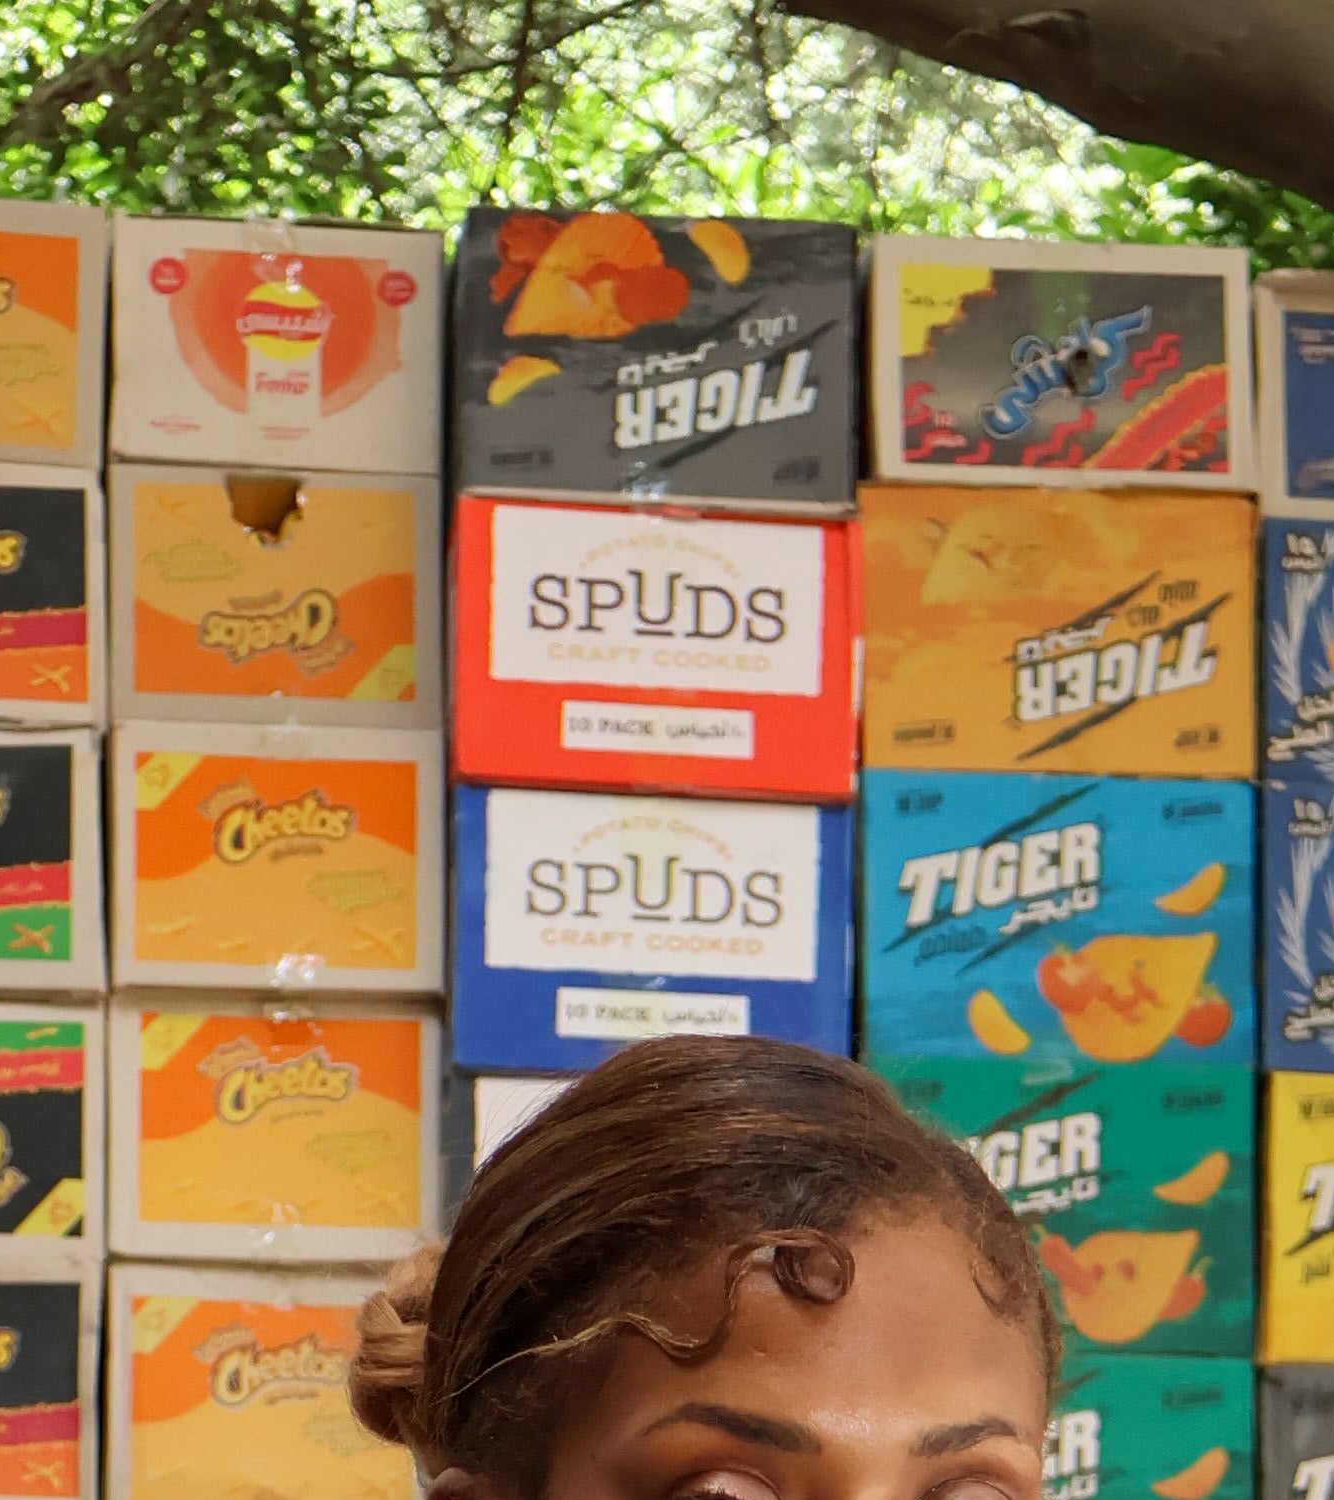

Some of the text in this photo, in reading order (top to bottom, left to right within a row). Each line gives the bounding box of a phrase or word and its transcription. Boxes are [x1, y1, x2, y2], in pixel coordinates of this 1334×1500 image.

[615, 349, 821, 450] TIGER
[199, 589, 337, 660] Cheetos
[529, 568, 787, 644] SPUDS
[547, 641, 771, 673] CRAFT COOKED
[1018, 619, 1218, 722] TIGER
[567, 717, 592, 734] 10
[214, 791, 353, 865] Cheetos
[525, 852, 785, 929] SPUDS
[898, 822, 1102, 930] TIGER
[541, 928, 765, 956] CRAFT COOKED
[217, 1053, 358, 1126] Cheetos
[981, 1112, 1101, 1192] GER
[212, 1338, 348, 1408] Cheetos
